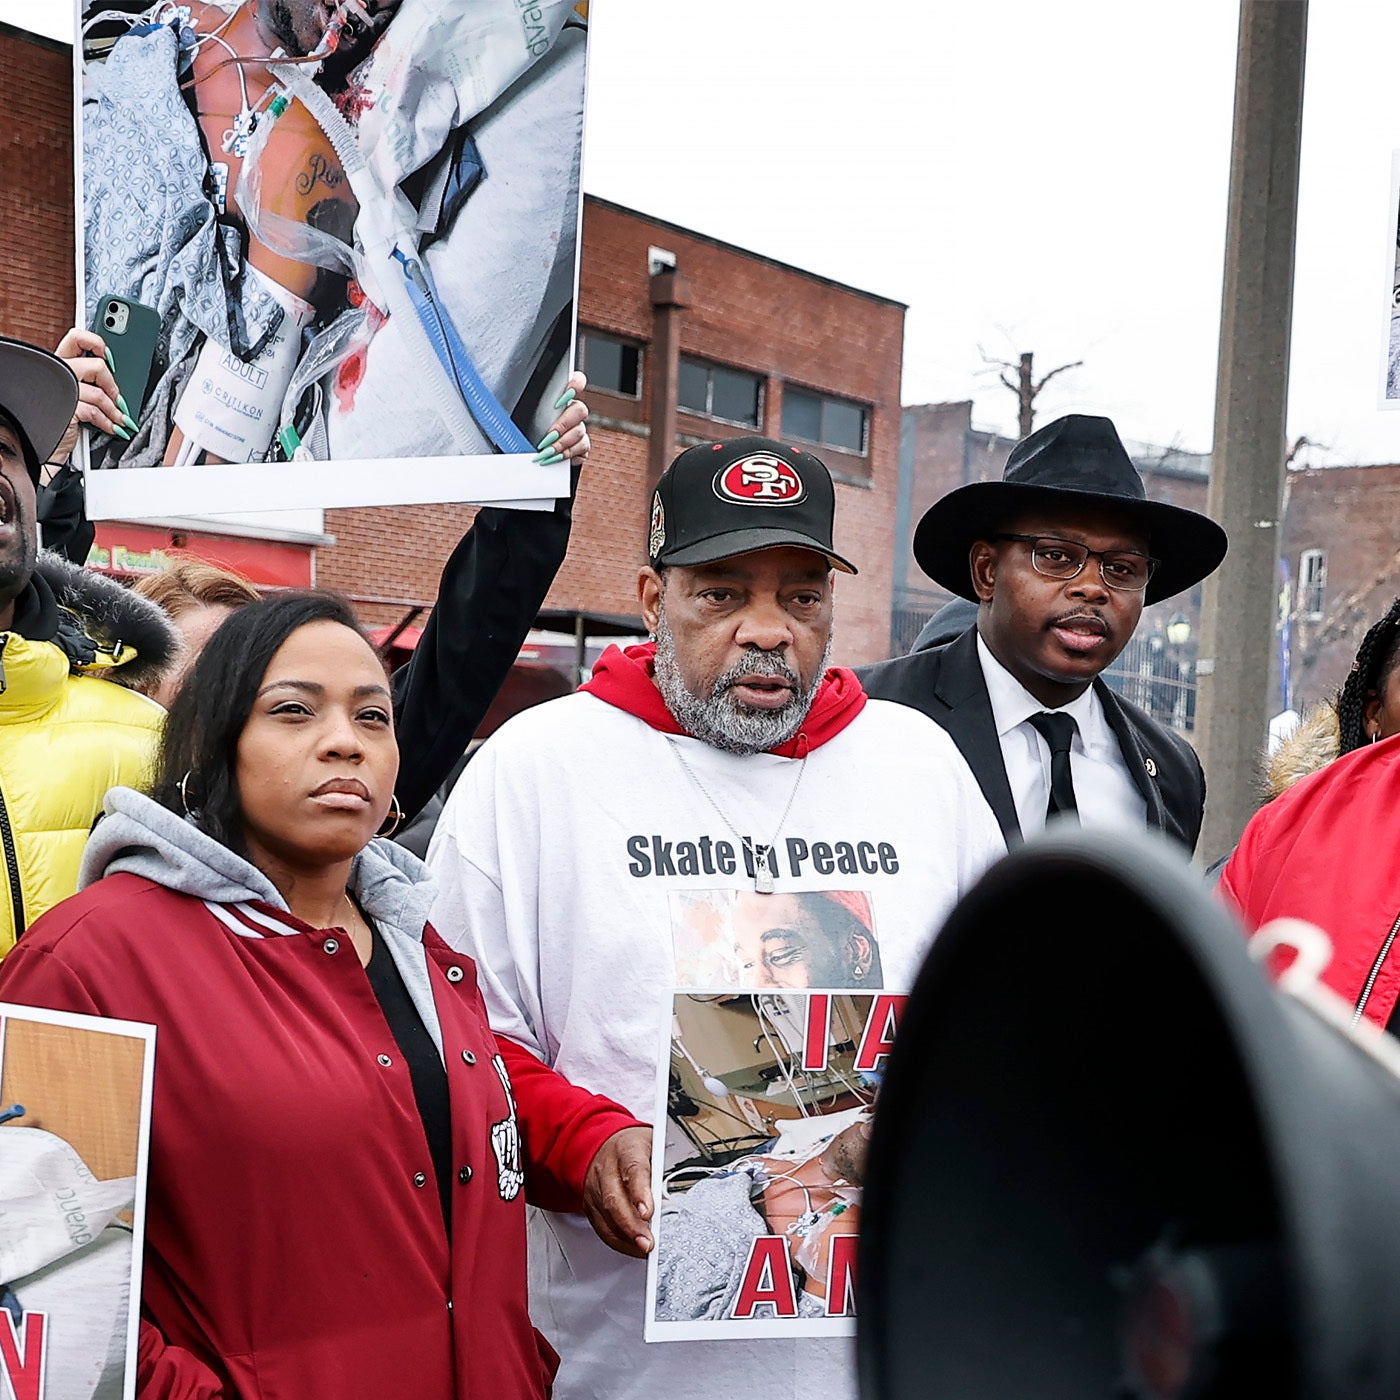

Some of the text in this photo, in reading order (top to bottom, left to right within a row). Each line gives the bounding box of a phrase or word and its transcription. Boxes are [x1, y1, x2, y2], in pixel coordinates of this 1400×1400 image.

[222, 354, 265, 385] ADULT
[741, 457, 796, 497] SF
[627, 835, 737, 878] Skate
[785, 837, 900, 878] Peace
[803, 994, 908, 1071] I A
[730, 1235, 798, 1318] A
